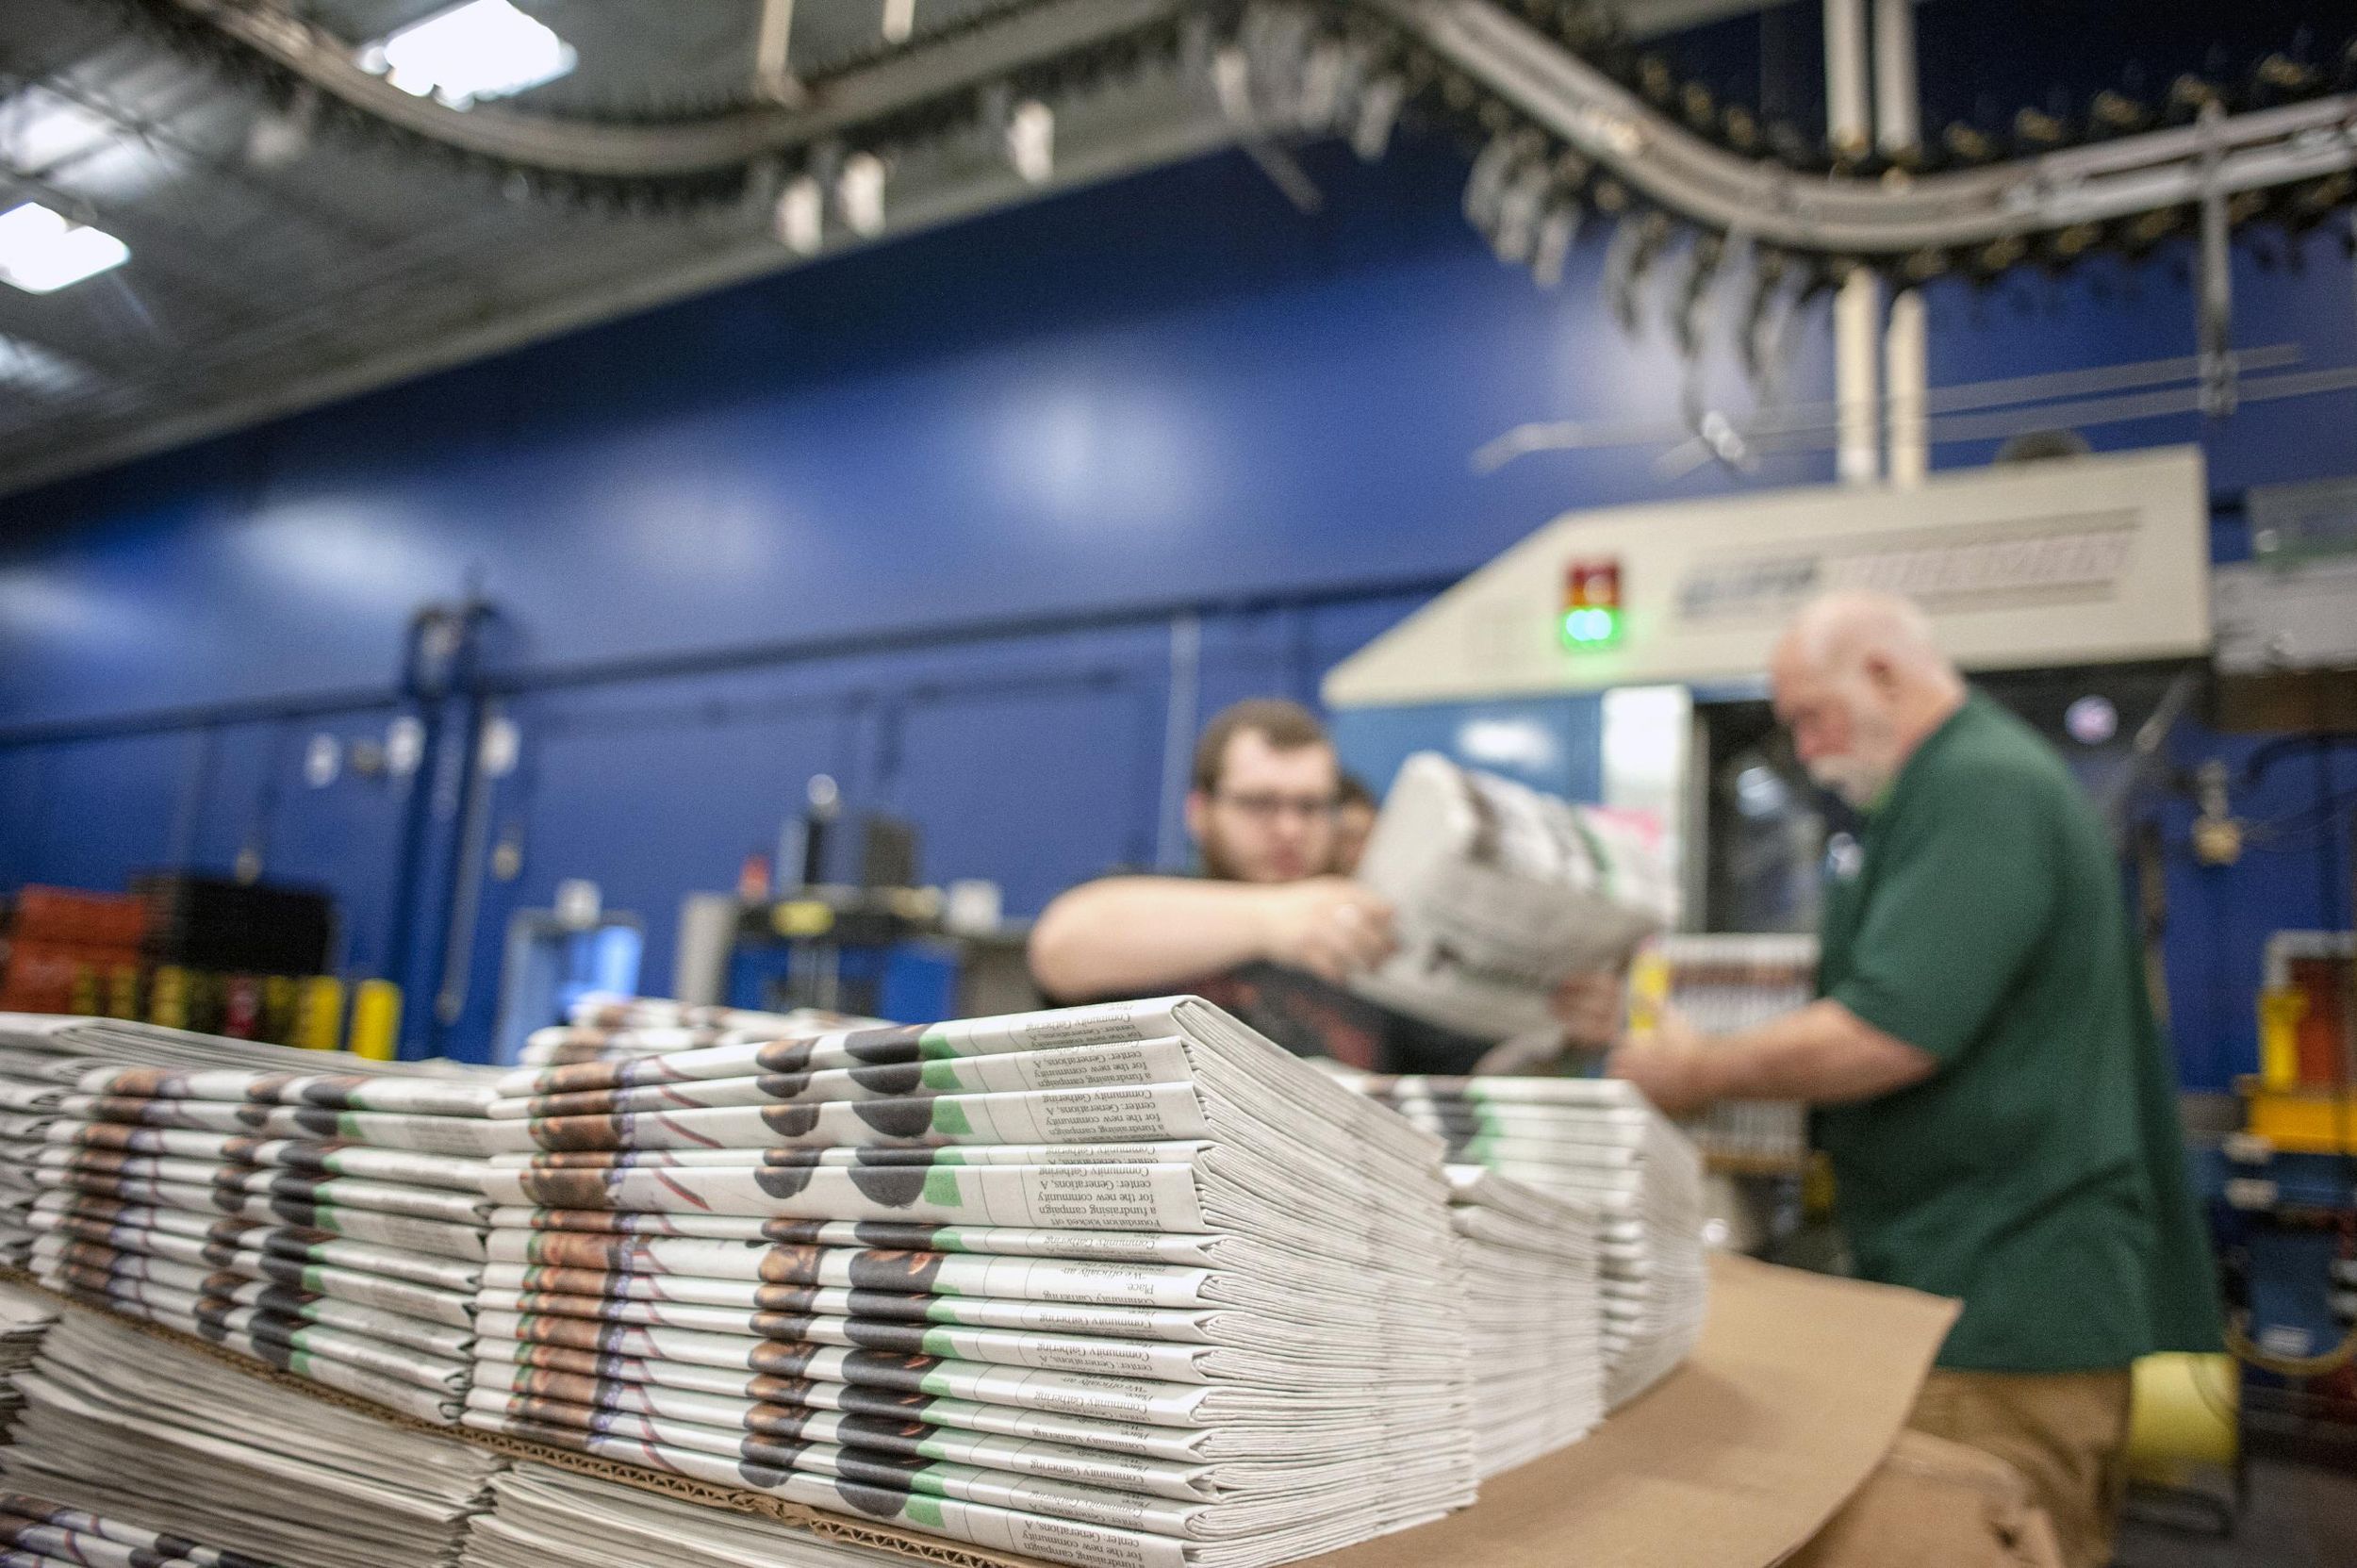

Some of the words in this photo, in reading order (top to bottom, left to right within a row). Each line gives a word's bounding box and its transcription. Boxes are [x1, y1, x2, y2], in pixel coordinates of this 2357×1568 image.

[1091, 1065, 1111, 1074] new
[1113, 1064, 1129, 1073] the
[1132, 1062, 1146, 1070] for
[1034, 1067, 1087, 1079] community
[1038, 1078, 1084, 1087] campaign
[1084, 1073, 1143, 1084] fundraising
[1042, 1094, 1091, 1103] Gathering
[1094, 1090, 1152, 1101] Community
[1046, 1116, 1099, 1126] community
[1048, 1127, 1096, 1135] campaign
[1098, 1124, 1156, 1133] fundraising
[1039, 1168, 1087, 1177] Gathering
[1092, 1167, 1148, 1177] Community
[1041, 1180, 1048, 1190] A
[1038, 1192, 1092, 1203] community
[1120, 1194, 1135, 1203] the
[1139, 1194, 1154, 1203] for
[1039, 1205, 1086, 1215] campaign
[1090, 1205, 1147, 1216] fundraising
[1036, 1344, 1086, 1356] Gathering
[1090, 1347, 1149, 1362] Community
[1087, 1399, 1146, 1413] Community
[1025, 1521, 1033, 1529] A
[1022, 1531, 1079, 1548] community
[1024, 1543, 1073, 1558] campaign
[1081, 1543, 1103, 1553] new
[1106, 1548, 1123, 1560] the
[1126, 1552, 1142, 1561] for
